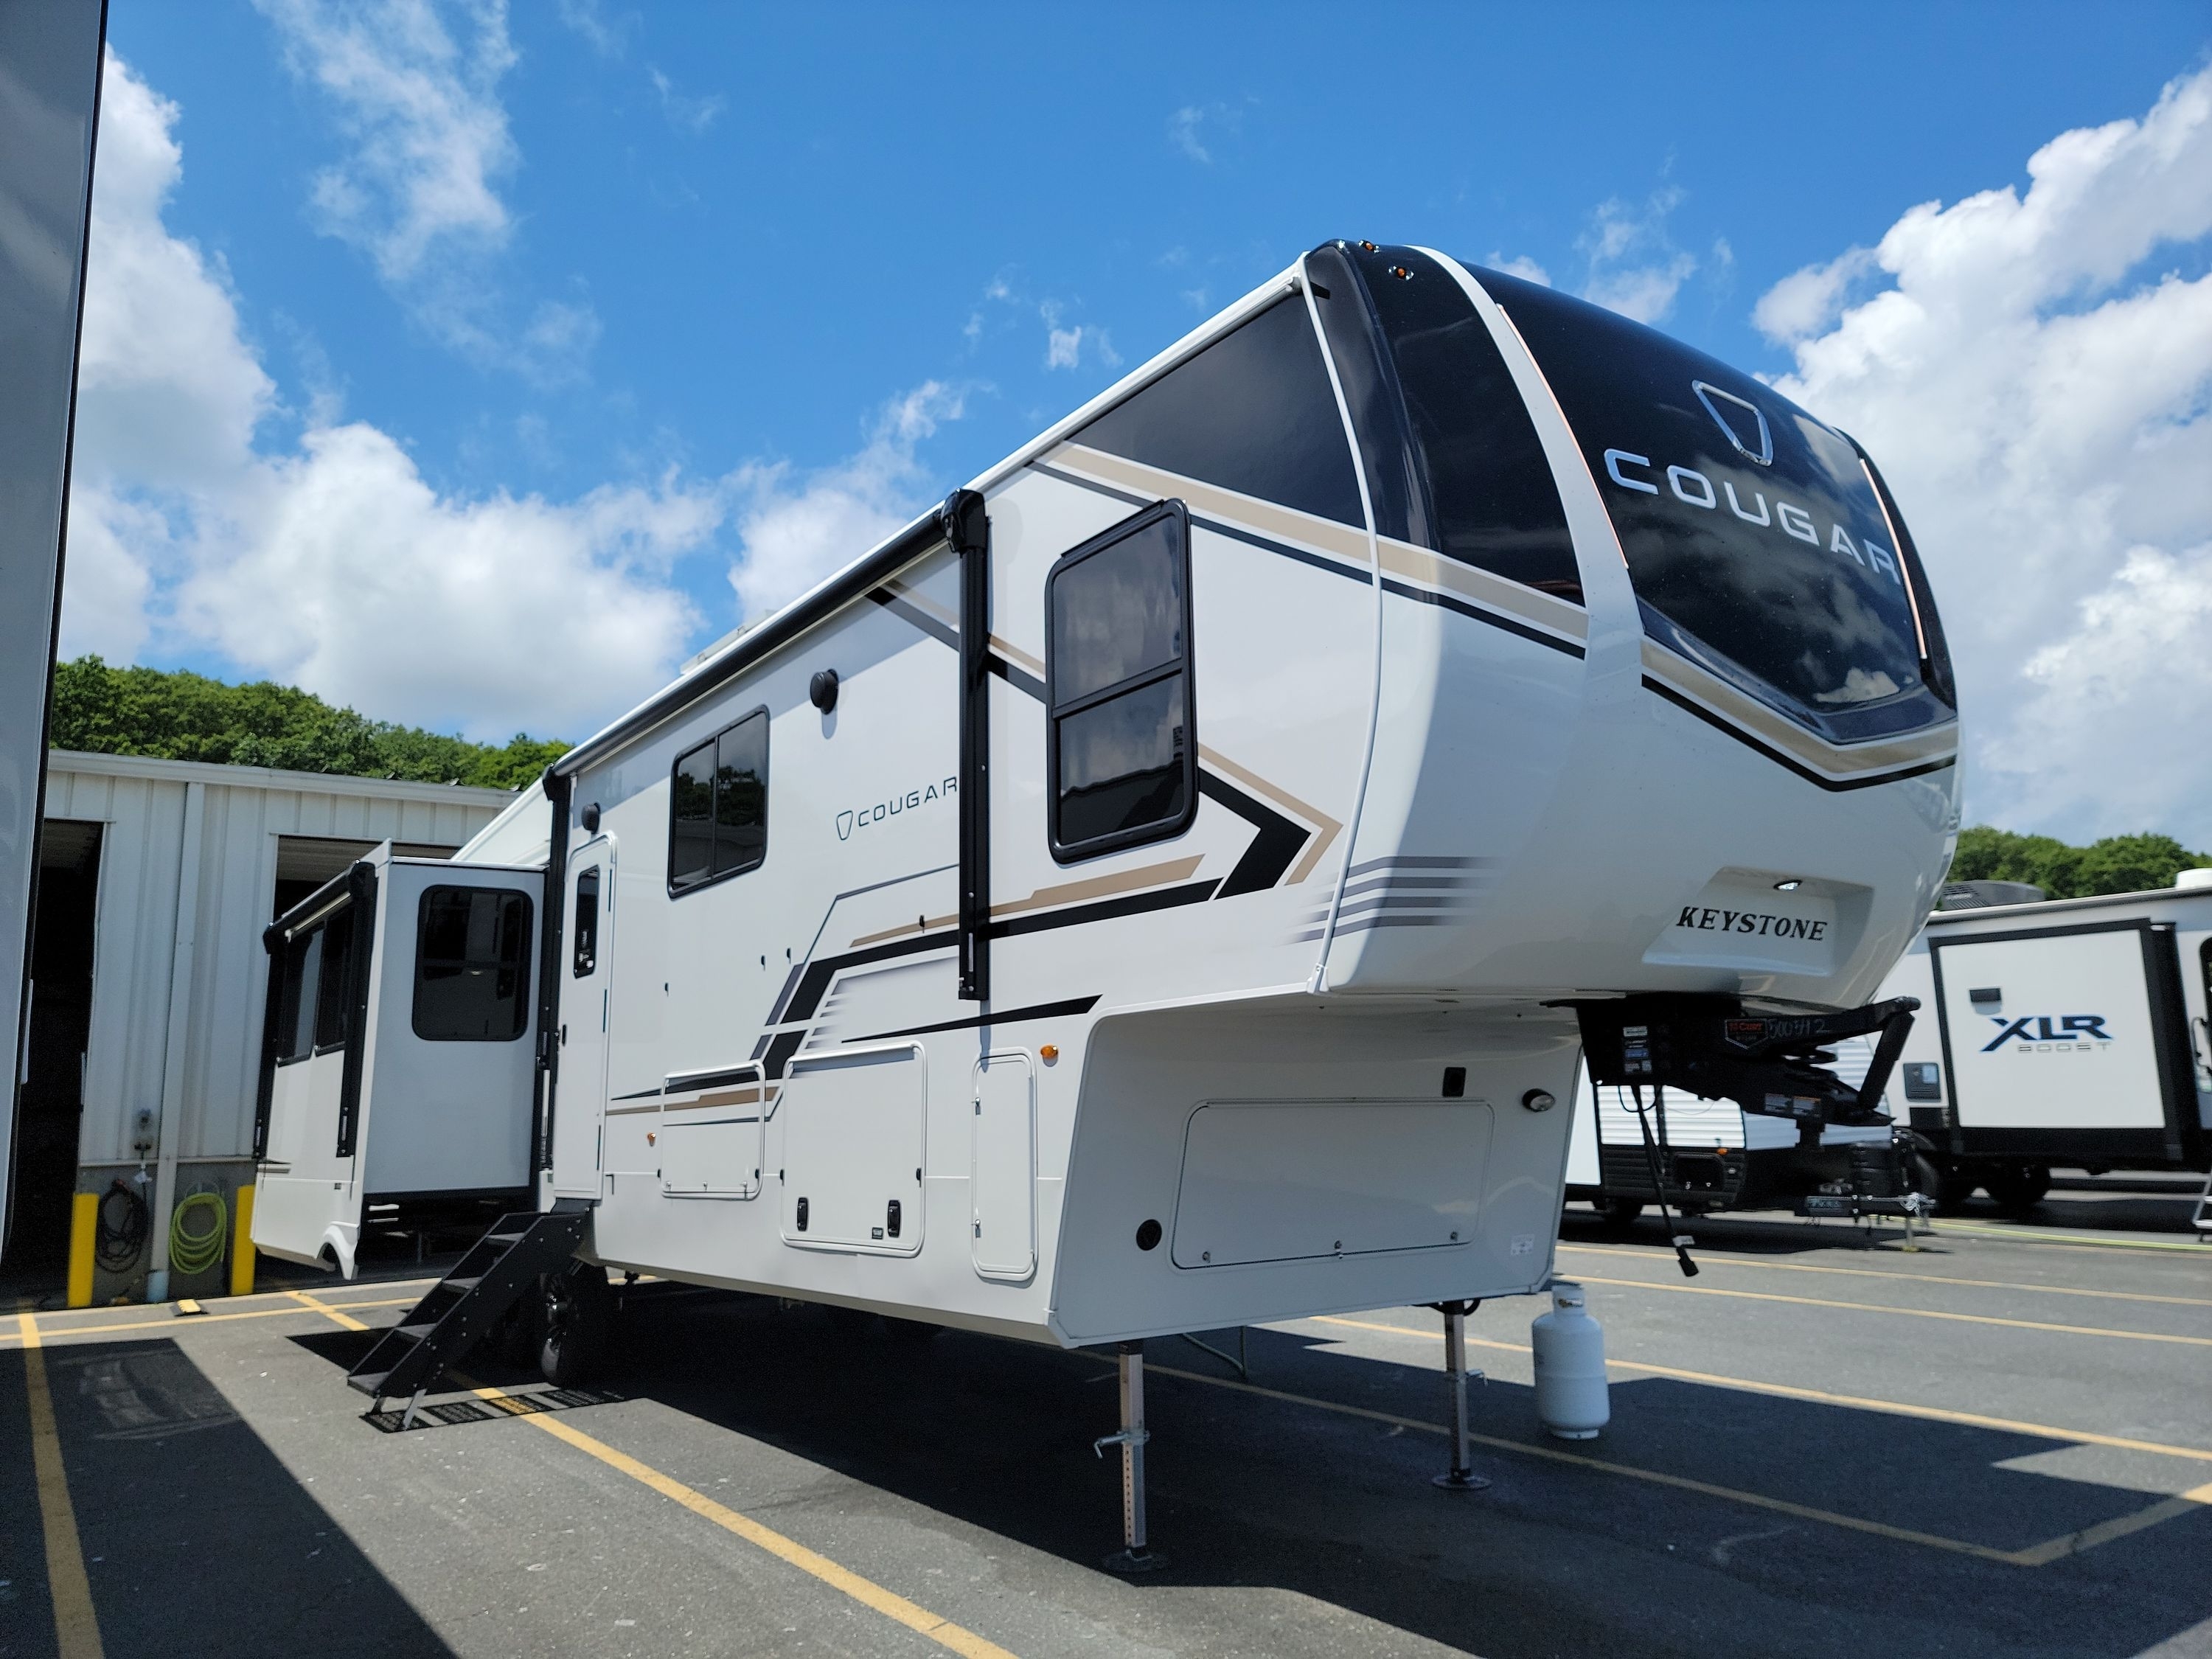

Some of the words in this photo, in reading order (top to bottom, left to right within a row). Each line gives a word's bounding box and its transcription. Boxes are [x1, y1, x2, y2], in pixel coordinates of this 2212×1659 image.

[1604, 448, 1901, 585] COUGAR
[858, 776, 957, 827] COUGAR
[1676, 906, 1828, 942] KEYSTONE
[1979, 1015, 2113, 1052] XLR
[2018, 1043, 2111, 1052] BOOST
